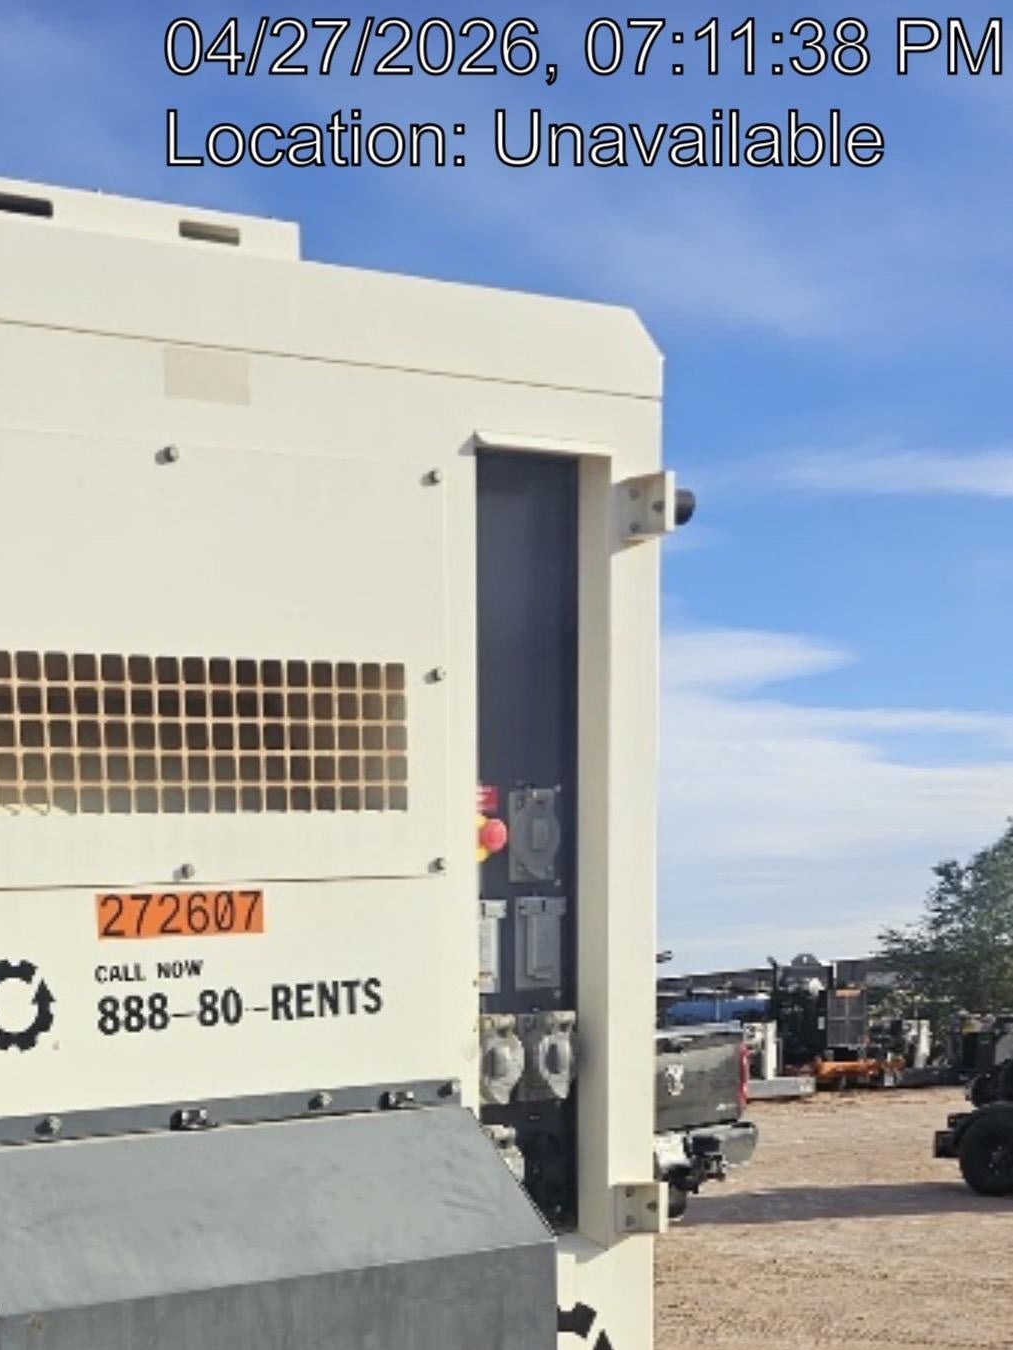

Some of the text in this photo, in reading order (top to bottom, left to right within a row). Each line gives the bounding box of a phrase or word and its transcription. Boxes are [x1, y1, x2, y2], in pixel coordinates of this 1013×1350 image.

[99, 890, 263, 938] 272607
[94, 959, 204, 983] CALL NOW
[96, 976, 384, 1036] 888-80-RENTS
